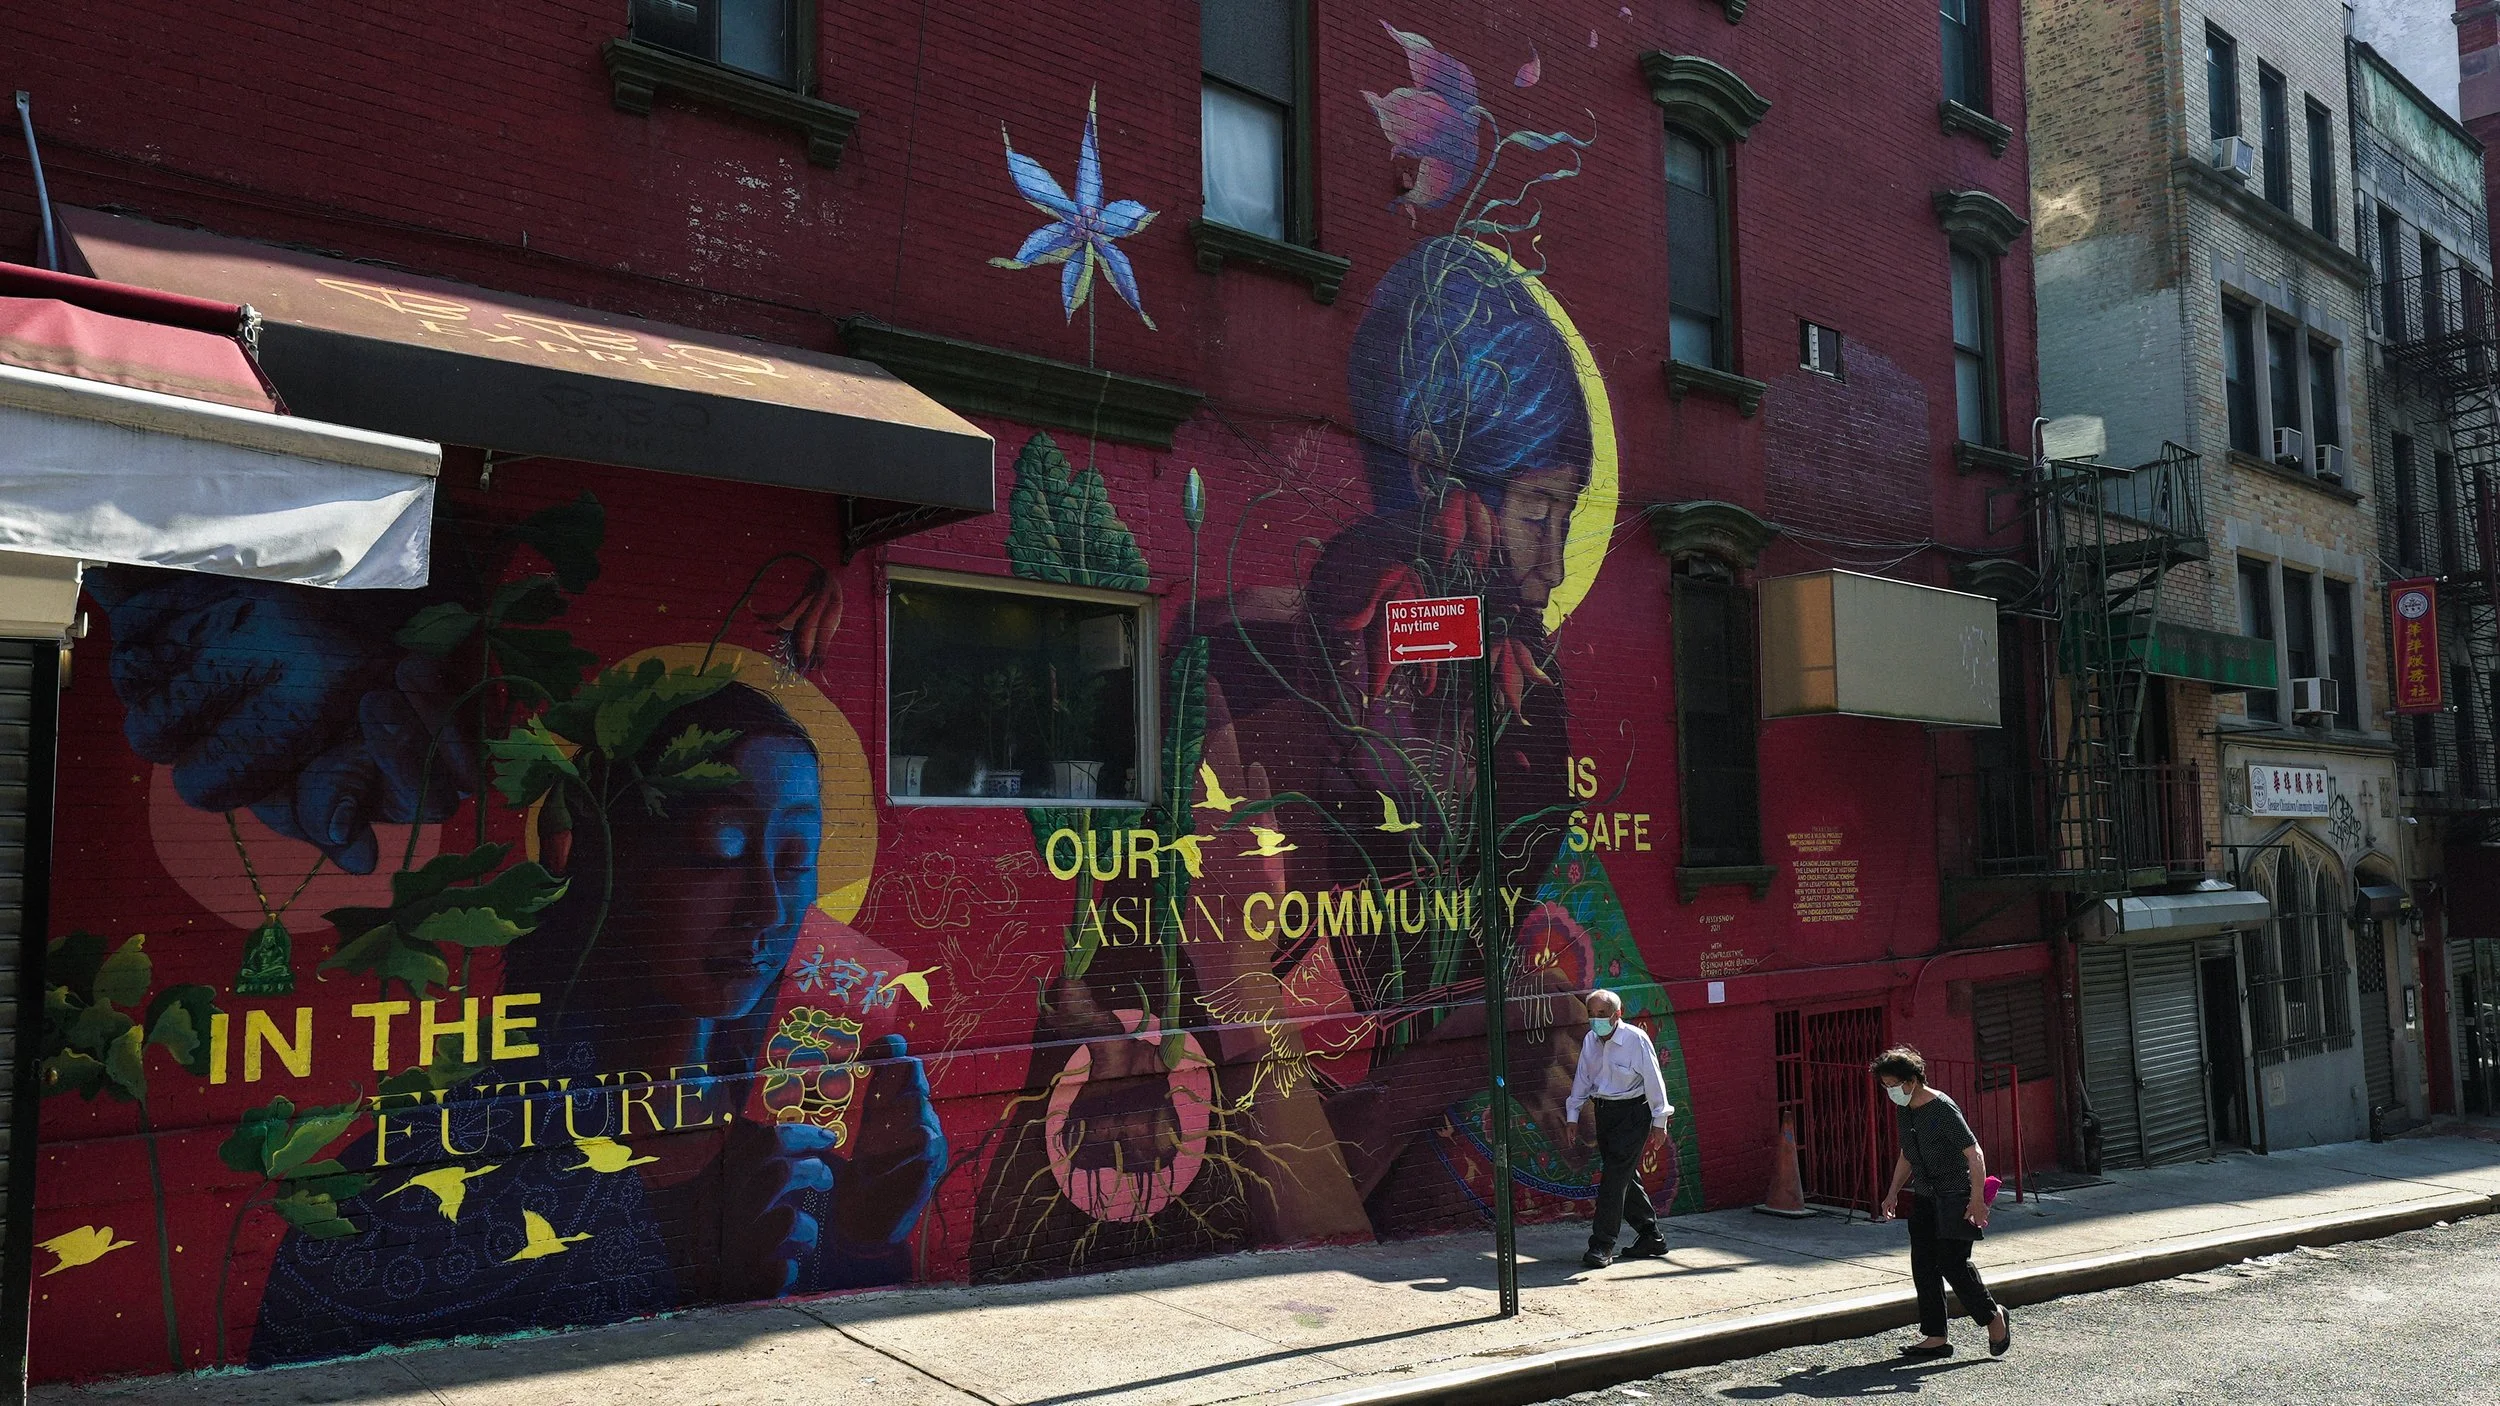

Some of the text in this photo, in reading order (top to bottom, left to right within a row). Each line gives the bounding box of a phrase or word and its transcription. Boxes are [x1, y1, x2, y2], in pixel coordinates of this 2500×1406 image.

[418, 319, 755, 386] EXPRESS
[1391, 604, 1465, 619] NO STANDING
[1393, 620, 1440, 635] Anytime
[1567, 756, 1598, 799] IS
[1045, 828, 1160, 881] OUR
[1568, 810, 1652, 852] SAFE
[1072, 886, 1523, 949] ASIAN COMMUNIY
[209, 992, 541, 1085] IN THE
